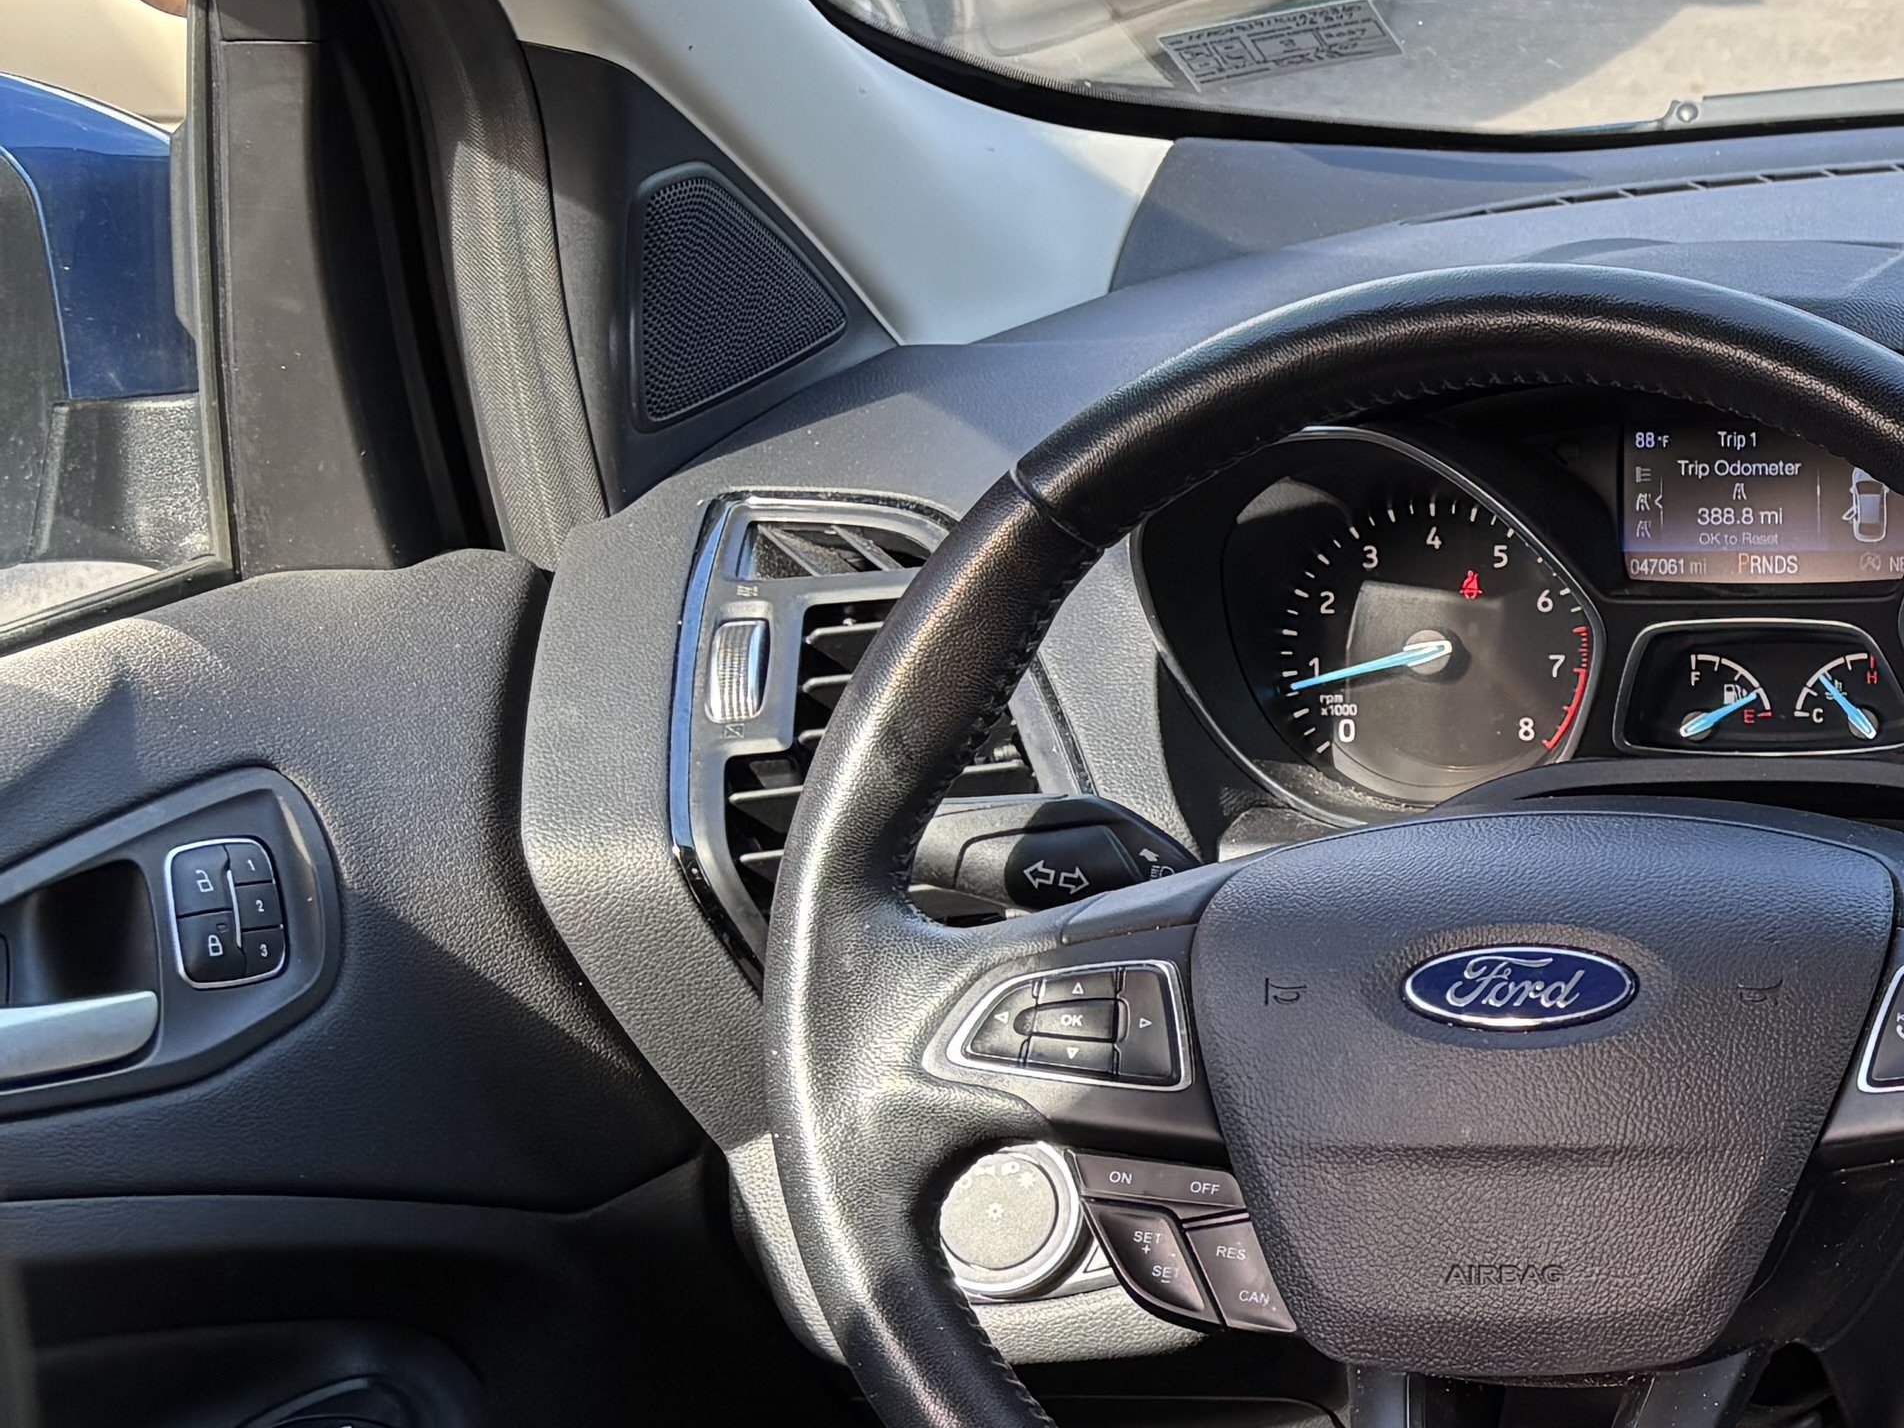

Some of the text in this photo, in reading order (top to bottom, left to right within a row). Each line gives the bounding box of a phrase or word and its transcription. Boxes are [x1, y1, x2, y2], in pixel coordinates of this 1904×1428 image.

[1717, 431, 1757, 450] Trip 1
[1677, 460, 1802, 477] Trip Odometer
[1697, 508, 1783, 525] 388.8 mi
[1426, 526, 1442, 549] 4
[1699, 532, 1778, 546] OK to Reset
[1362, 546, 1378, 569] 3
[1493, 545, 1508, 568] 5
[1738, 553, 1798, 573] PRNDS
[1630, 559, 1707, 575] 047061 mi
[1320, 591, 1335, 614] 2
[1537, 590, 1553, 613] 6
[1309, 657, 1320, 677] 1
[1549, 655, 1565, 678] 7
[1691, 672, 1700, 686] F
[1866, 672, 1877, 684] H
[1320, 693, 1344, 704] rpm
[1321, 704, 1357, 716] x1000
[1744, 709, 1755, 723] E
[1812, 709, 1823, 723] C
[1338, 719, 1356, 742] 0
[1518, 717, 1535, 741] 8
[247, 859, 256, 871] 1
[255, 899, 265, 912] 2
[259, 944, 268, 957] 3
[1445, 955, 1586, 1009] Ford
[1060, 1014, 1084, 1027] OK
[1109, 1171, 1133, 1185] ON
[1190, 1181, 1220, 1196] OFF
[1133, 1231, 1163, 1245] SET
[1215, 1246, 1247, 1261] RES
[1151, 1265, 1179, 1278] SET
[1445, 1264, 1565, 1285] AIRBAG
[1238, 1290, 1270, 1306] CAN
